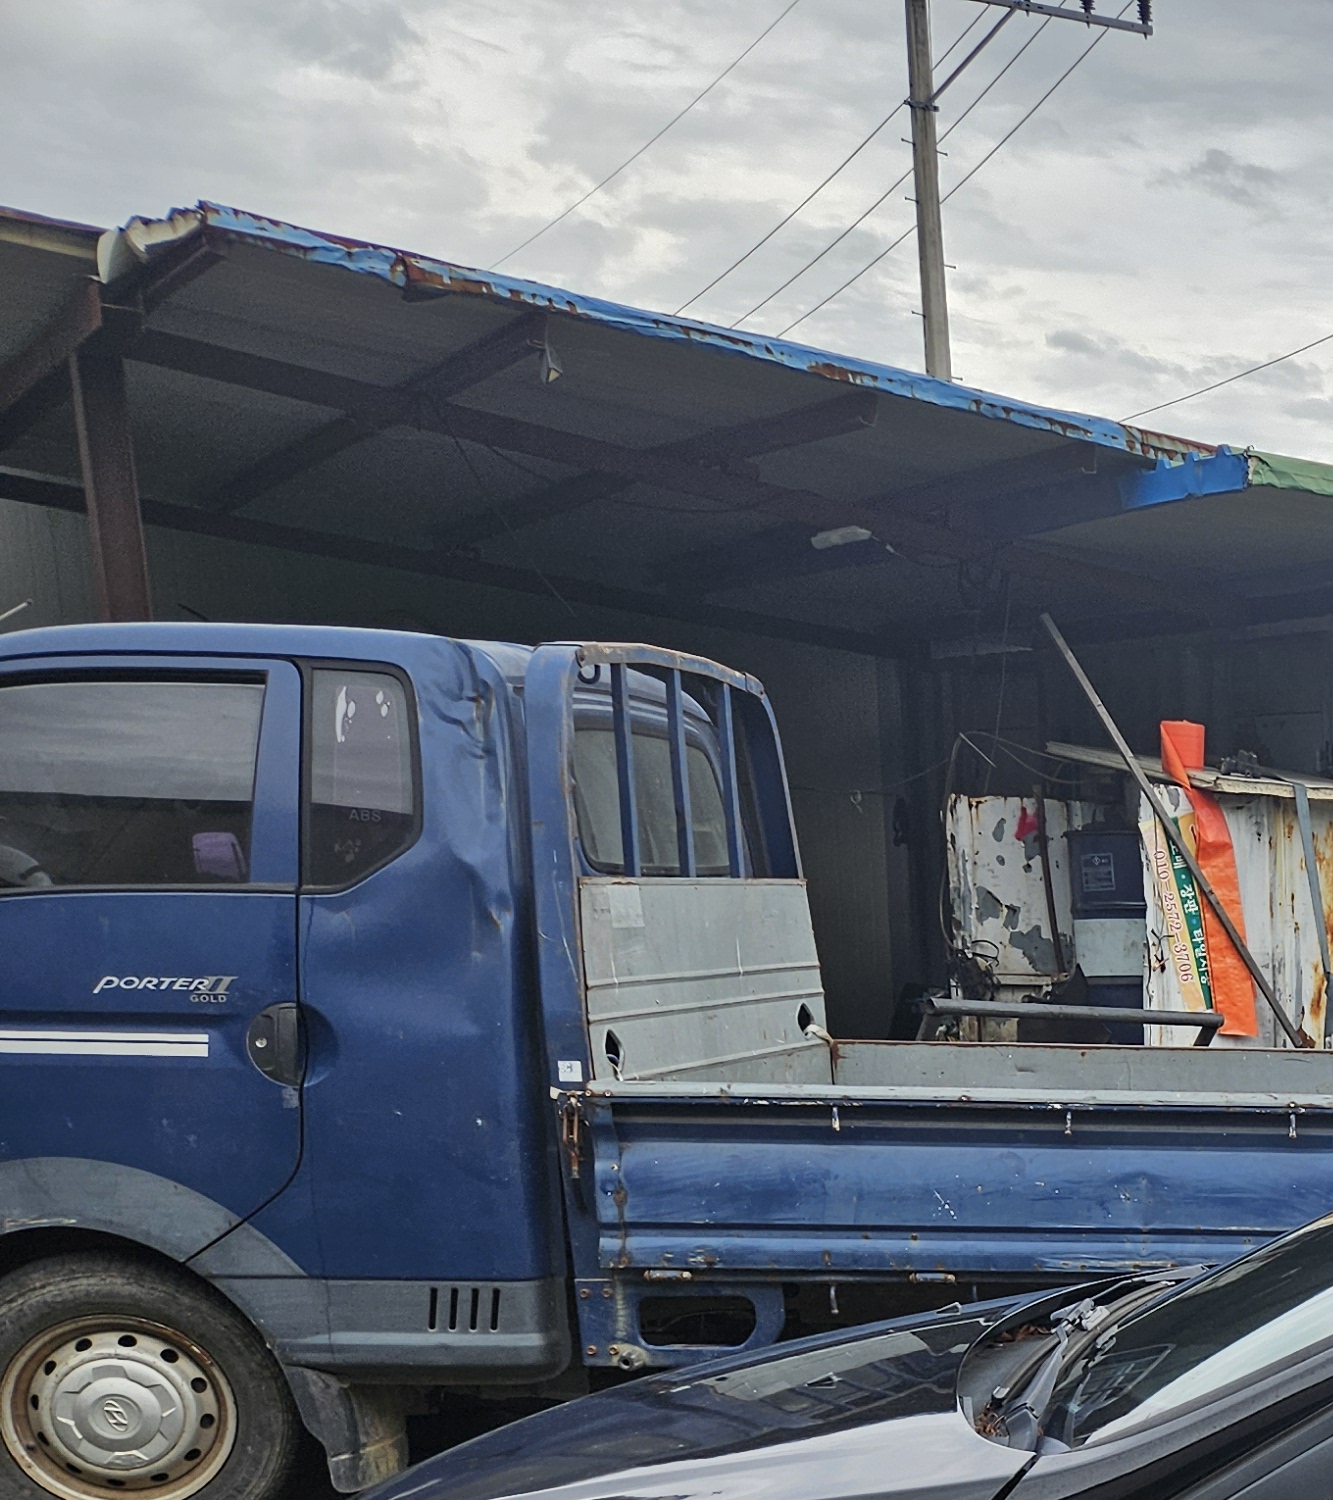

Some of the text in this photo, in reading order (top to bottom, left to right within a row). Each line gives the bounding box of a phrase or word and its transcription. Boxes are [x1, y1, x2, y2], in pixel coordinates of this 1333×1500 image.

[349, 808, 381, 822] ABS
[1180, 884, 1199, 915] 장판
[1153, 850, 1194, 982] 010-2572-3706
[190, 995, 227, 1003] GOLD
